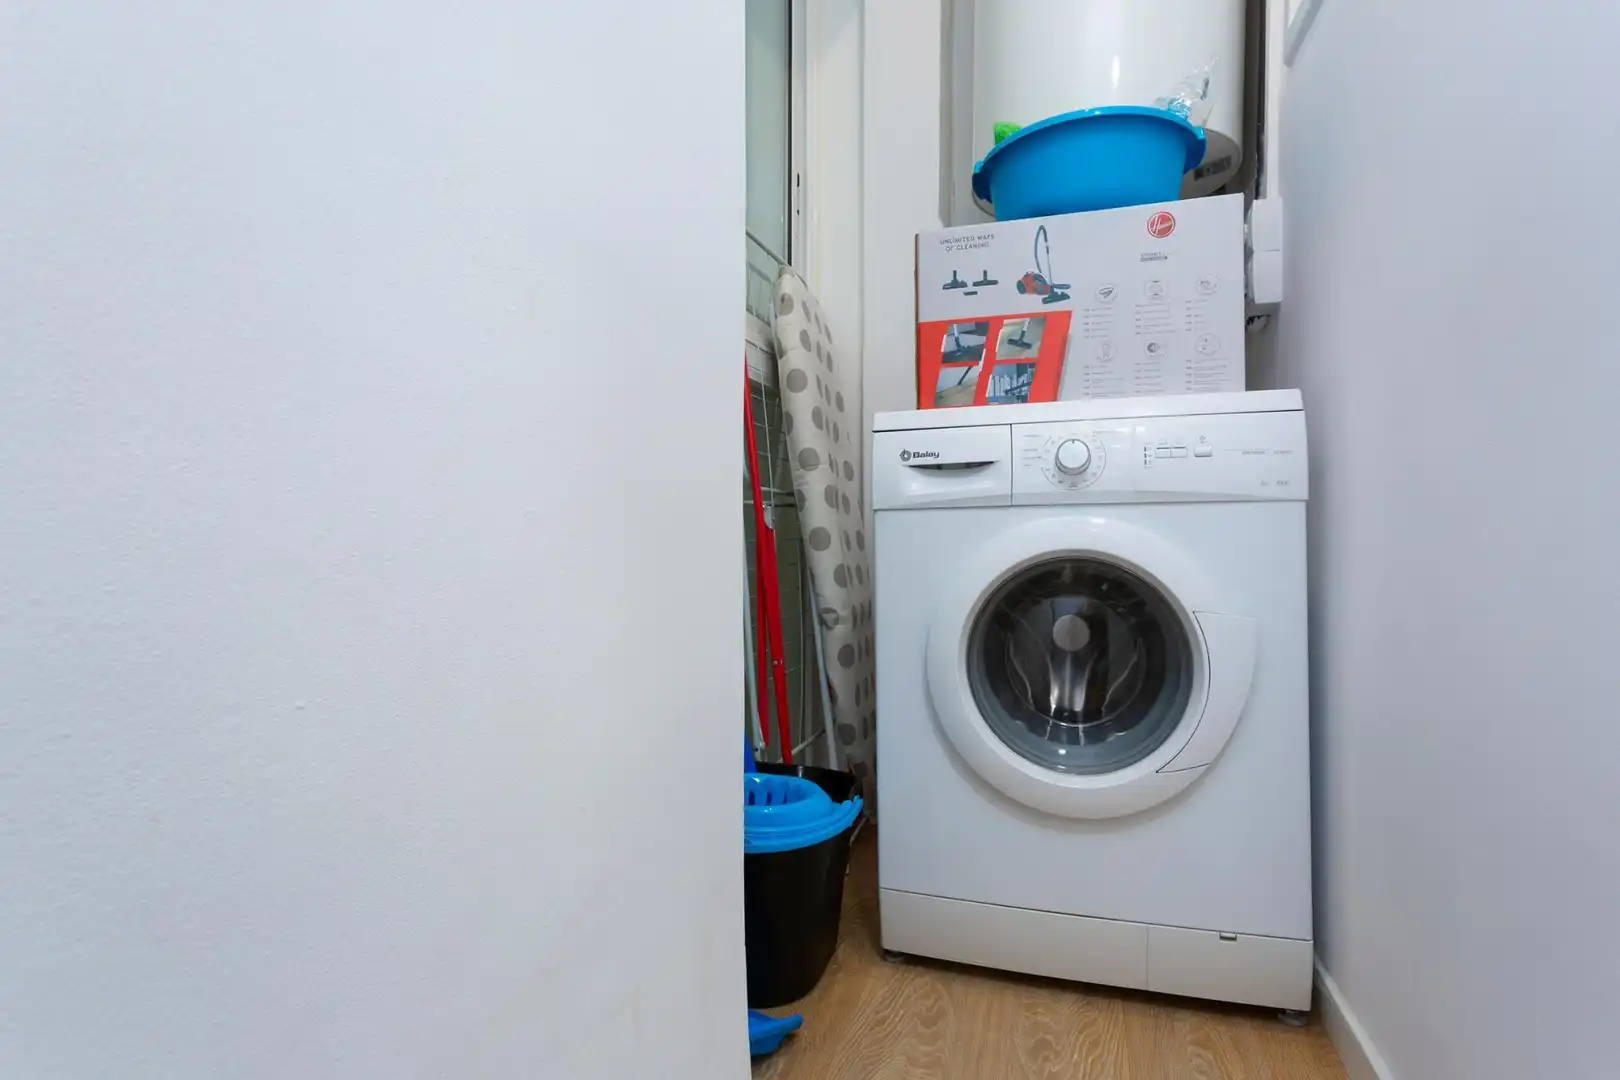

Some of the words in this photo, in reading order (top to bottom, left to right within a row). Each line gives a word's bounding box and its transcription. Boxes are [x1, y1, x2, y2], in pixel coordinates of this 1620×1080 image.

[940, 235, 975, 245] UNLIMITED
[977, 233, 995, 241] WAYS
[956, 242, 989, 251] CLEANING
[912, 451, 940, 459] Balay
